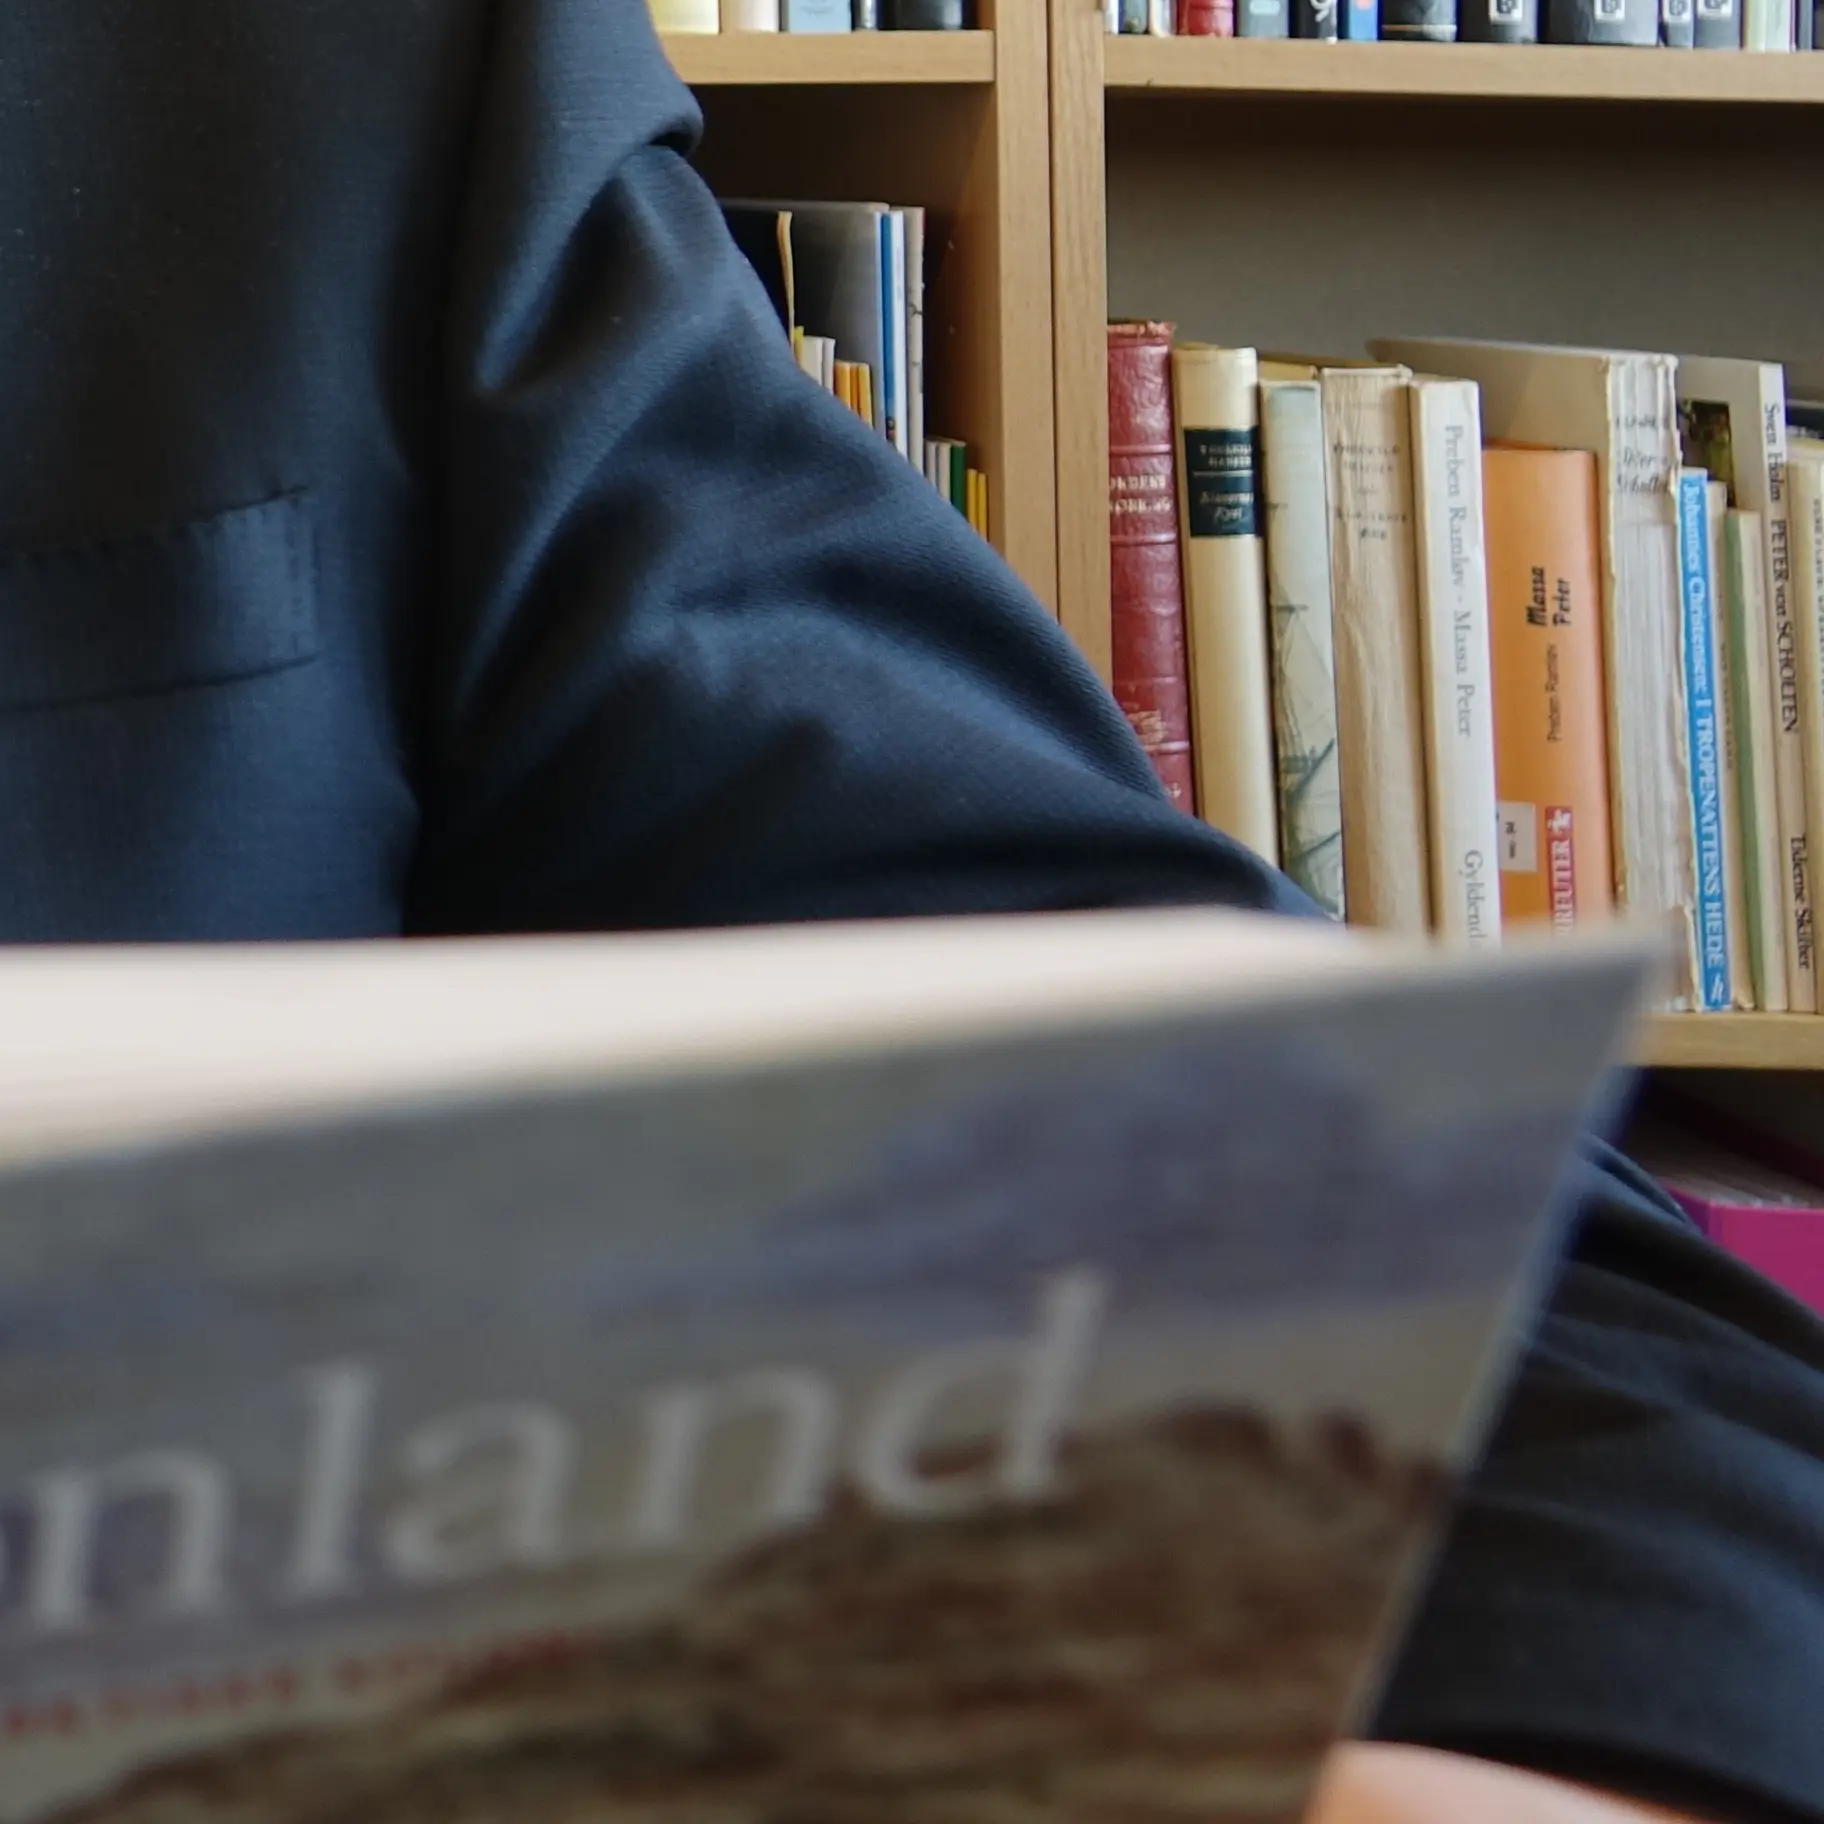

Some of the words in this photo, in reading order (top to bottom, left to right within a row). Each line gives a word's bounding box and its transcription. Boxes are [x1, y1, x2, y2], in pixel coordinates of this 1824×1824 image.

[1681, 484, 1708, 572] Johannes
[1526, 567, 1548, 626] Massa
[1551, 578, 1571, 626] Peter
[1686, 577, 1714, 691] Christensen:
[1693, 711, 1724, 897] TROPENATTENS
[1703, 903, 1727, 967] HEDE
